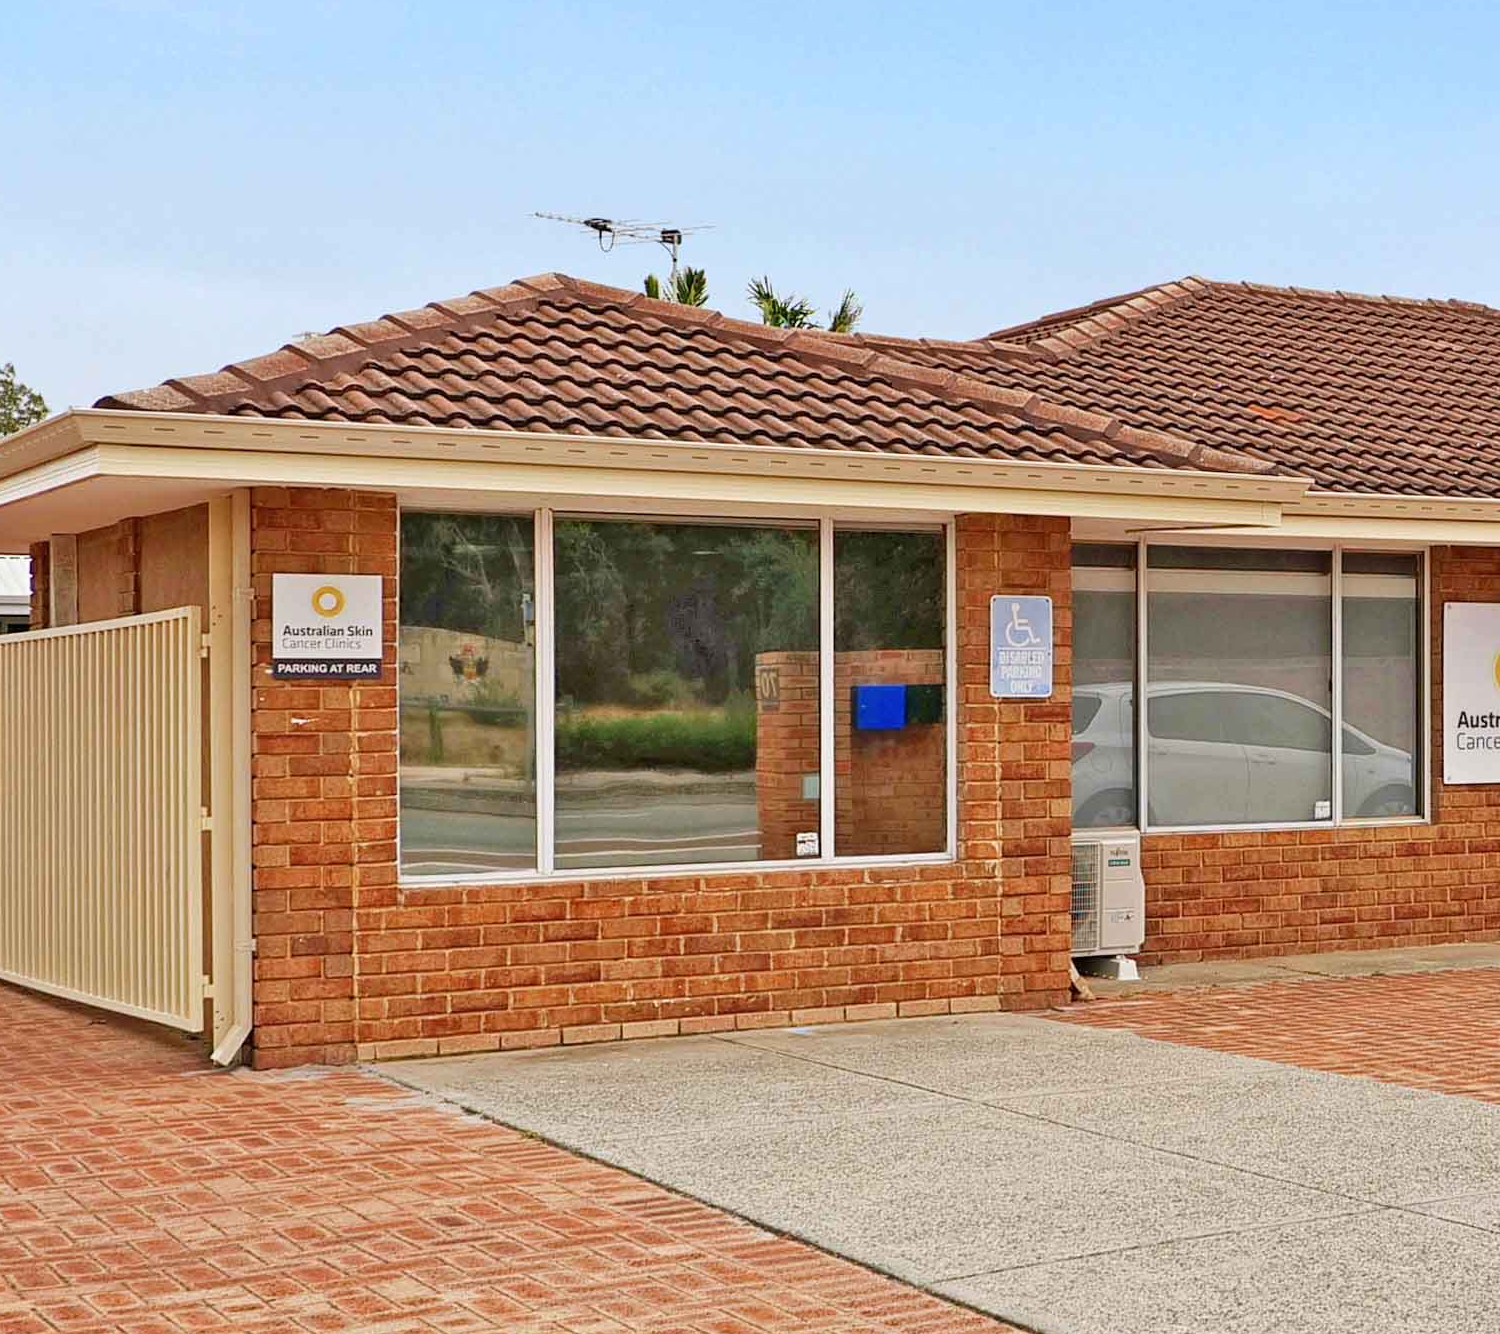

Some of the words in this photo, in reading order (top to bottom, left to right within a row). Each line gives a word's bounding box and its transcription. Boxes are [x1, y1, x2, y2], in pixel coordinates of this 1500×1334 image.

[283, 625, 345, 636] Australian
[347, 625, 373, 636] Skin
[282, 638, 321, 649] Cancer
[325, 638, 362, 649] Clinics
[277, 663, 328, 673] PARKING
[329, 663, 344, 673] AT
[346, 663, 377, 673] REAR
